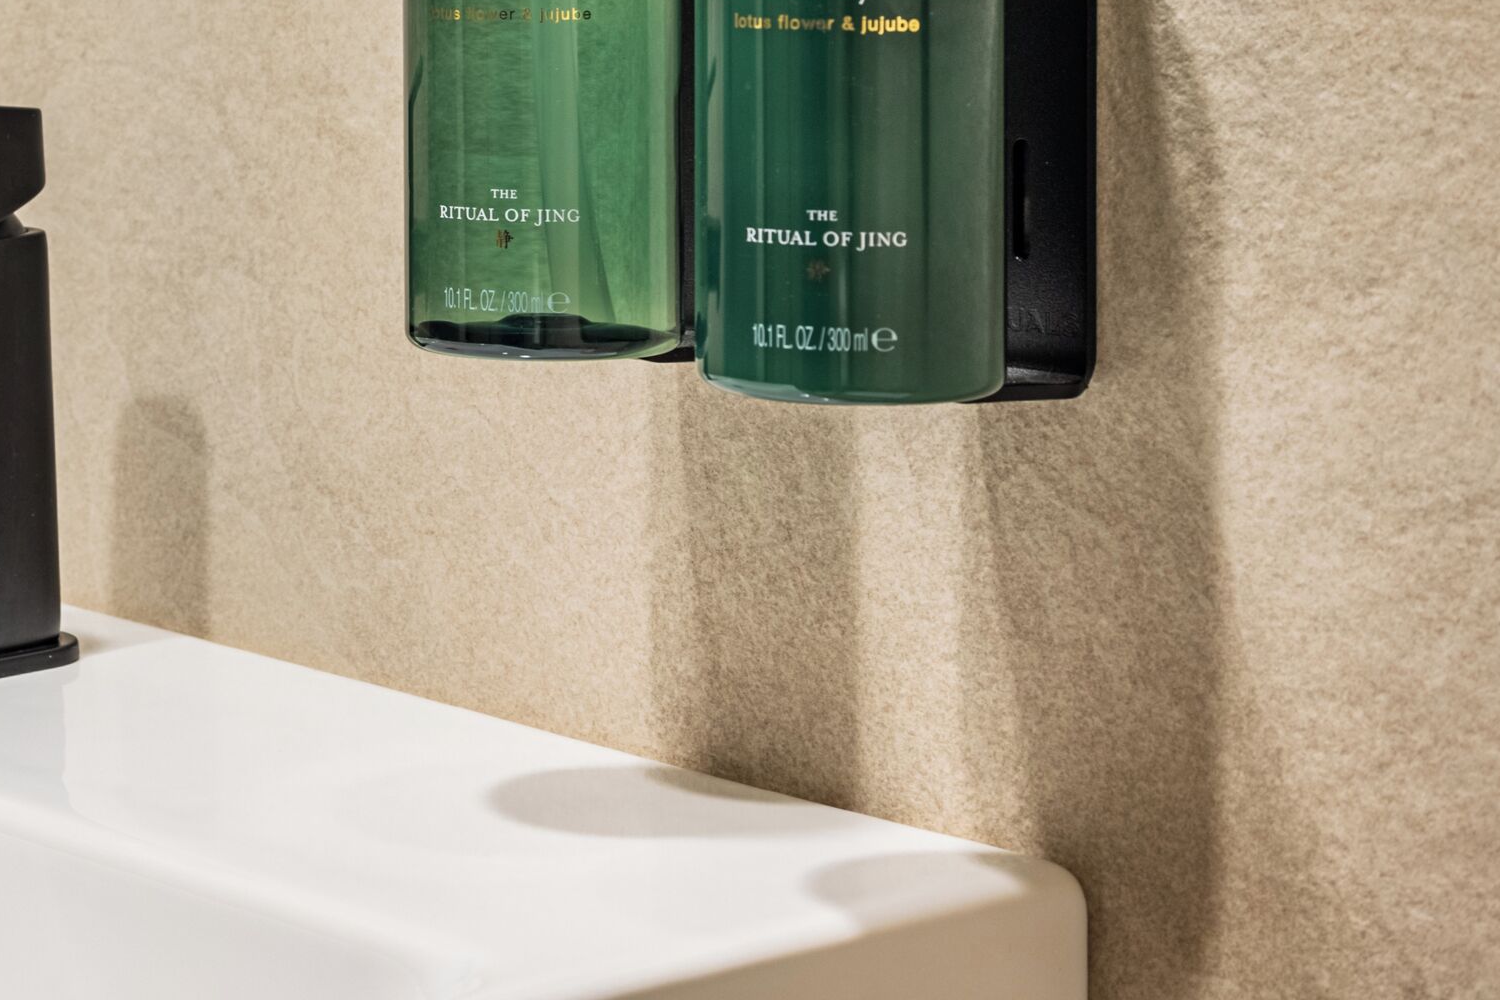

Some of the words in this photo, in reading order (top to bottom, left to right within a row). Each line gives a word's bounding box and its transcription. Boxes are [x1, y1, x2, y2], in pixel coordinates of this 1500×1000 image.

[539, 7, 593, 24] jujube
[734, 12, 772, 30] lotus
[777, 13, 836, 32] flower
[841, 15, 855, 32] &
[860, 15, 921, 36] jujube
[490, 188, 518, 200] THE
[439, 204, 500, 223] RITUAL
[504, 207, 531, 224] OF
[533, 208, 581, 227] JING
[806, 209, 839, 223] THE
[746, 226, 817, 247] RITUAL
[822, 230, 853, 248] OF
[856, 230, 909, 252] JING
[443, 286, 461, 309] 10.1
[508, 291, 529, 313] 300
[751, 323, 773, 348] 10.1
[827, 327, 851, 353] 300
[853, 327, 869, 352] ml
